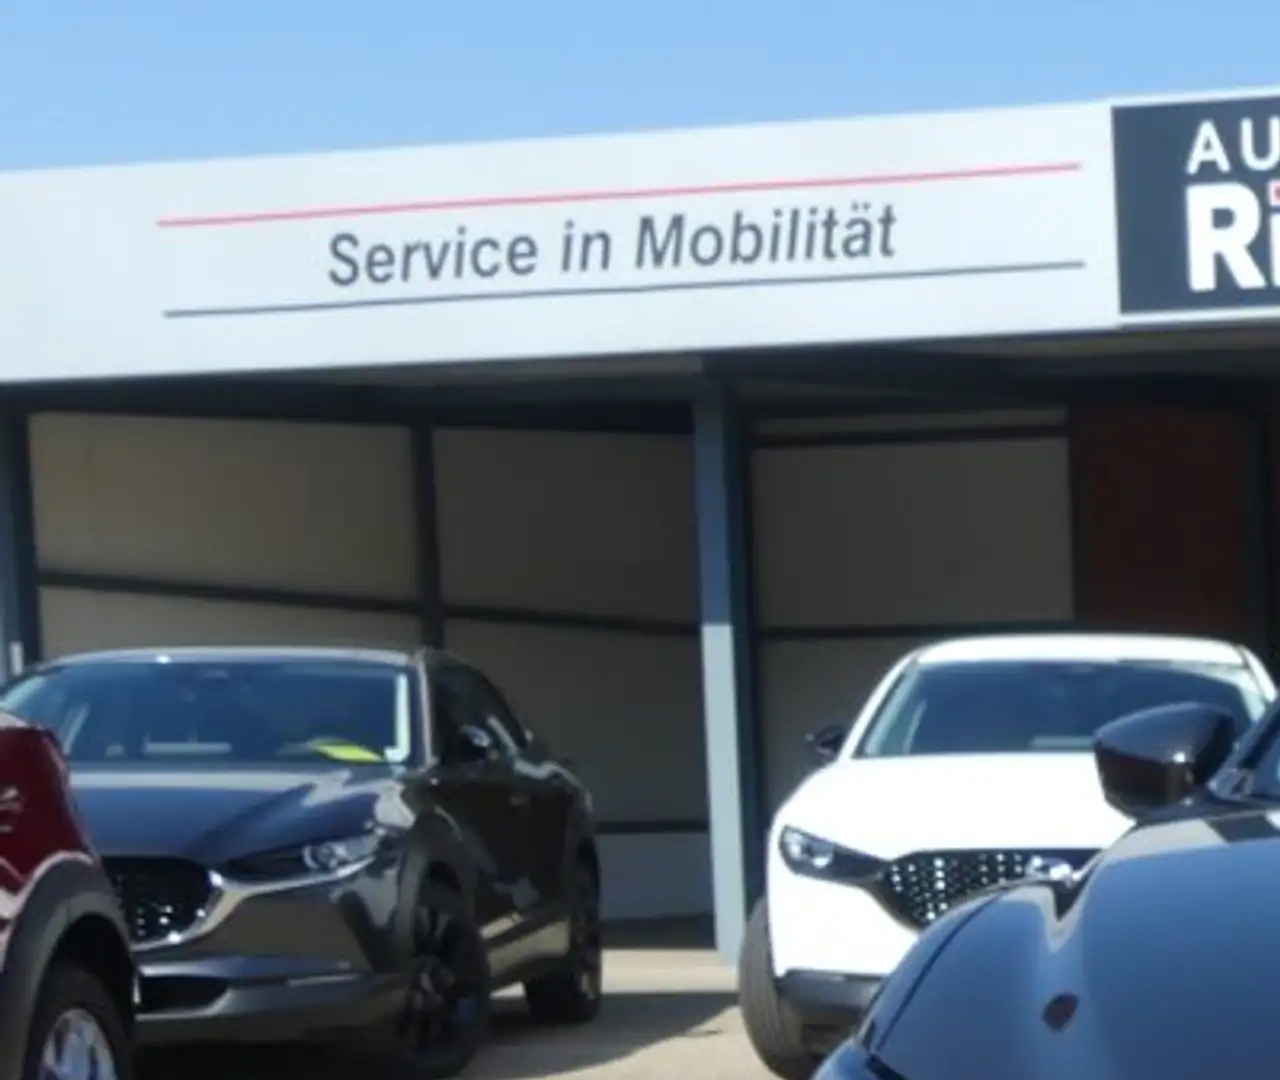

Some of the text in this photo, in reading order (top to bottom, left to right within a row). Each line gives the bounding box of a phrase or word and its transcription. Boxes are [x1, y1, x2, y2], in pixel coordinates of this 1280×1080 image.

[327, 202, 897, 287] Service in Mobilität
